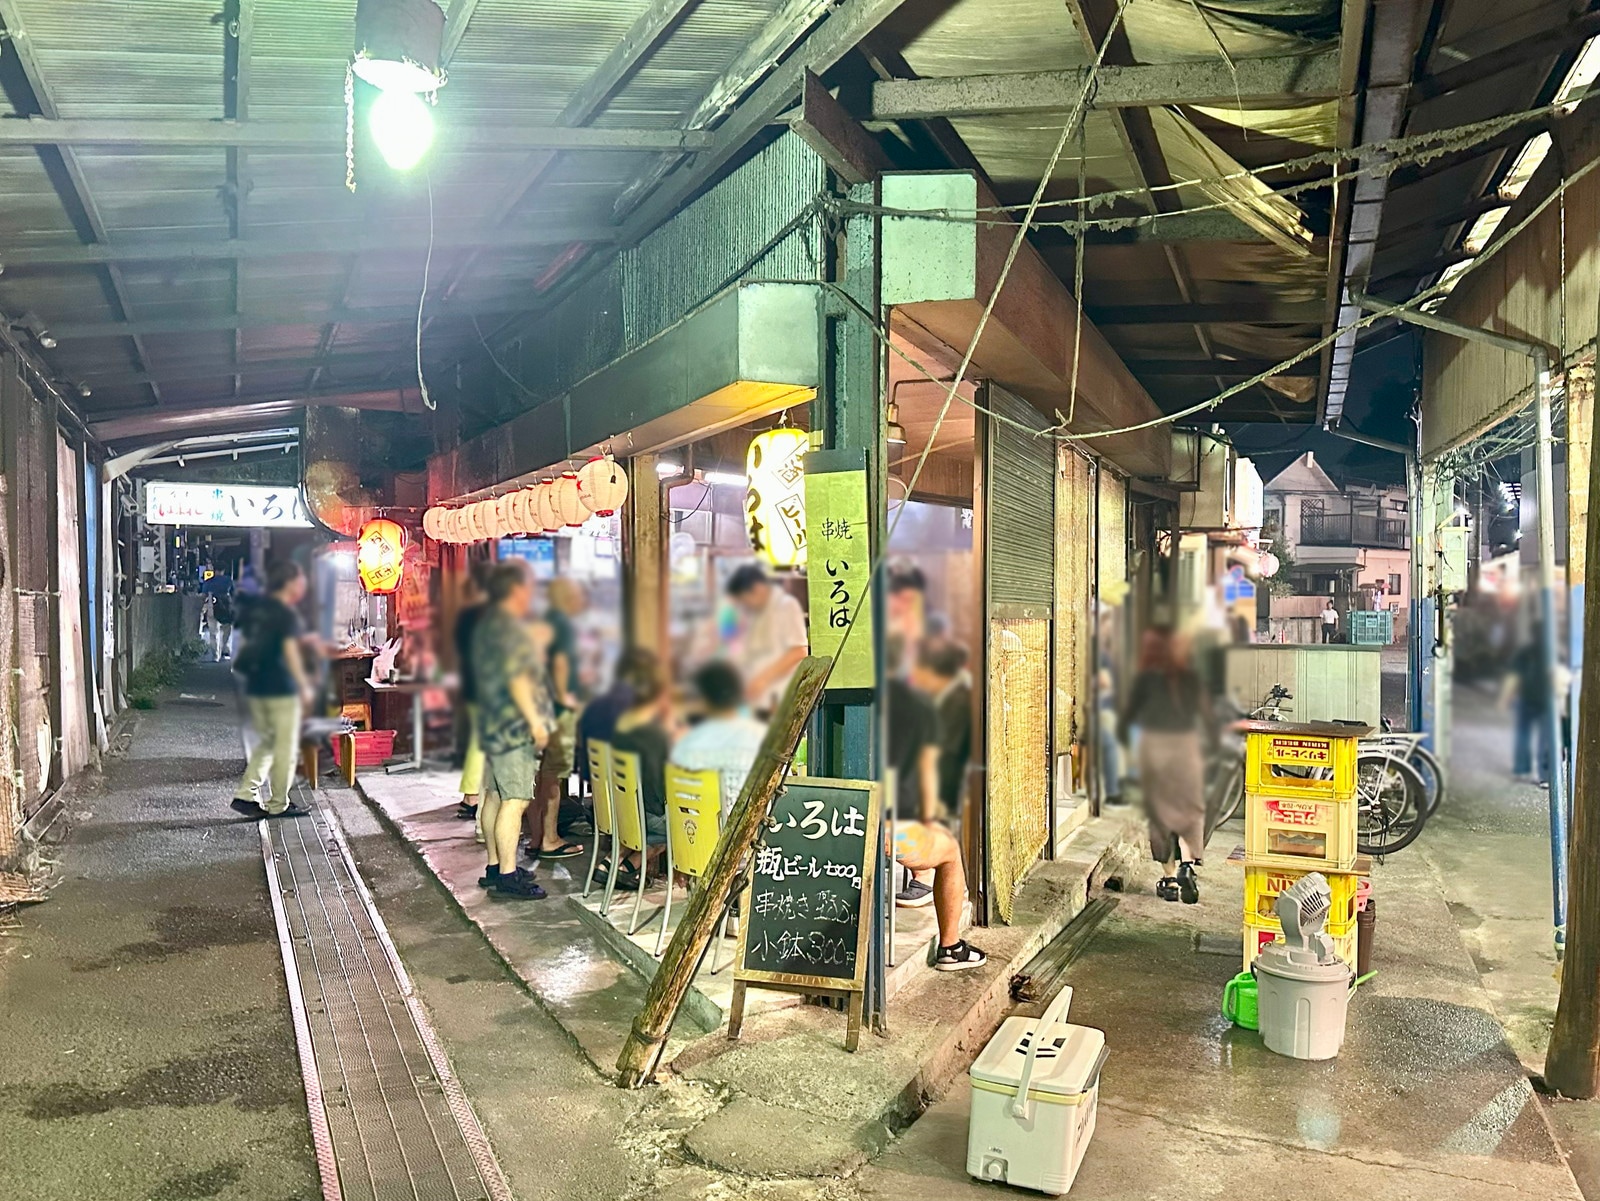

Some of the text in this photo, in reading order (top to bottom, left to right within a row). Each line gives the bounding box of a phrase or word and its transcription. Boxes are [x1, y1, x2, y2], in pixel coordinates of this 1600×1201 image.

[821, 516, 853, 542] 串焼
[825, 558, 852, 629] いろは
[1275, 749, 1327, 760] キリンビール
[766, 799, 865, 840] いろは
